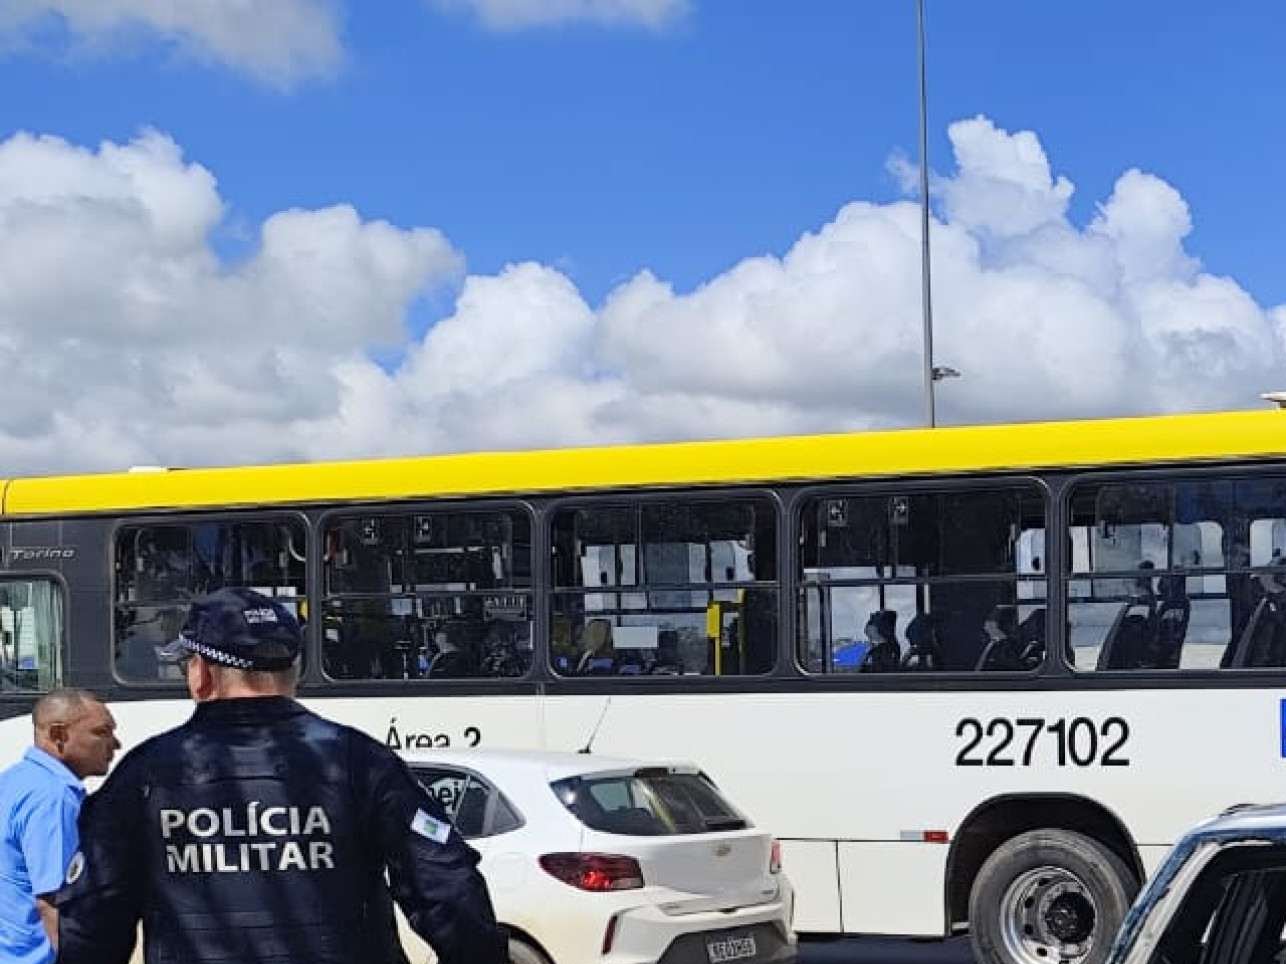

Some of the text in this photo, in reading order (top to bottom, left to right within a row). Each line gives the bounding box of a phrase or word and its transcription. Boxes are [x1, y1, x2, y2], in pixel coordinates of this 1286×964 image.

[955, 716, 1130, 767] 227102
[159, 801, 331, 839] POLÍCIA
[166, 841, 335, 873] MILITAR
